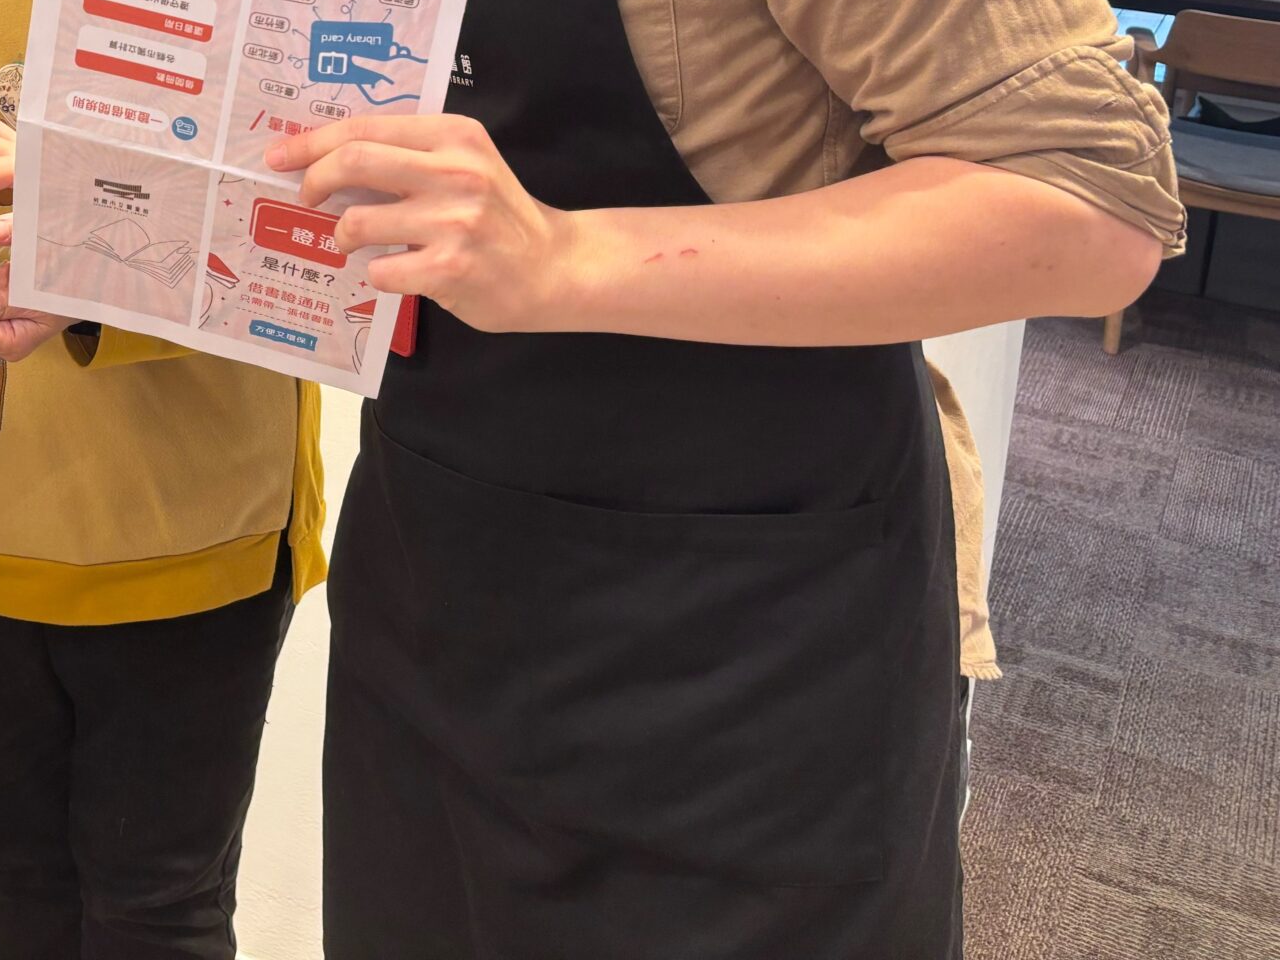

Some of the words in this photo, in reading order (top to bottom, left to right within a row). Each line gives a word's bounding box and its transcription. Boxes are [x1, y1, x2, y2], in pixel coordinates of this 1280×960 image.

[164, 18, 203, 36] 還書日期
[254, 15, 285, 29] 新竹市
[322, 34, 344, 43] card
[346, 33, 381, 45] Library
[109, 40, 175, 63] 各縣市獨立計算
[248, 47, 278, 61] 新北市
[155, 72, 194, 89] 借閱冊數
[264, 82, 295, 97] 臺北市
[73, 96, 162, 124] 一證通借閱規則
[314, 104, 345, 118] 桃園市
[267, 116, 312, 136] 圖書
[265, 226, 341, 254] 一證通
[261, 255, 335, 287] 是什麼？
[248, 282, 330, 313] 借書證通用
[240, 293, 334, 327] 只需帶一張借書證
[255, 324, 315, 348] 方便又環保！
